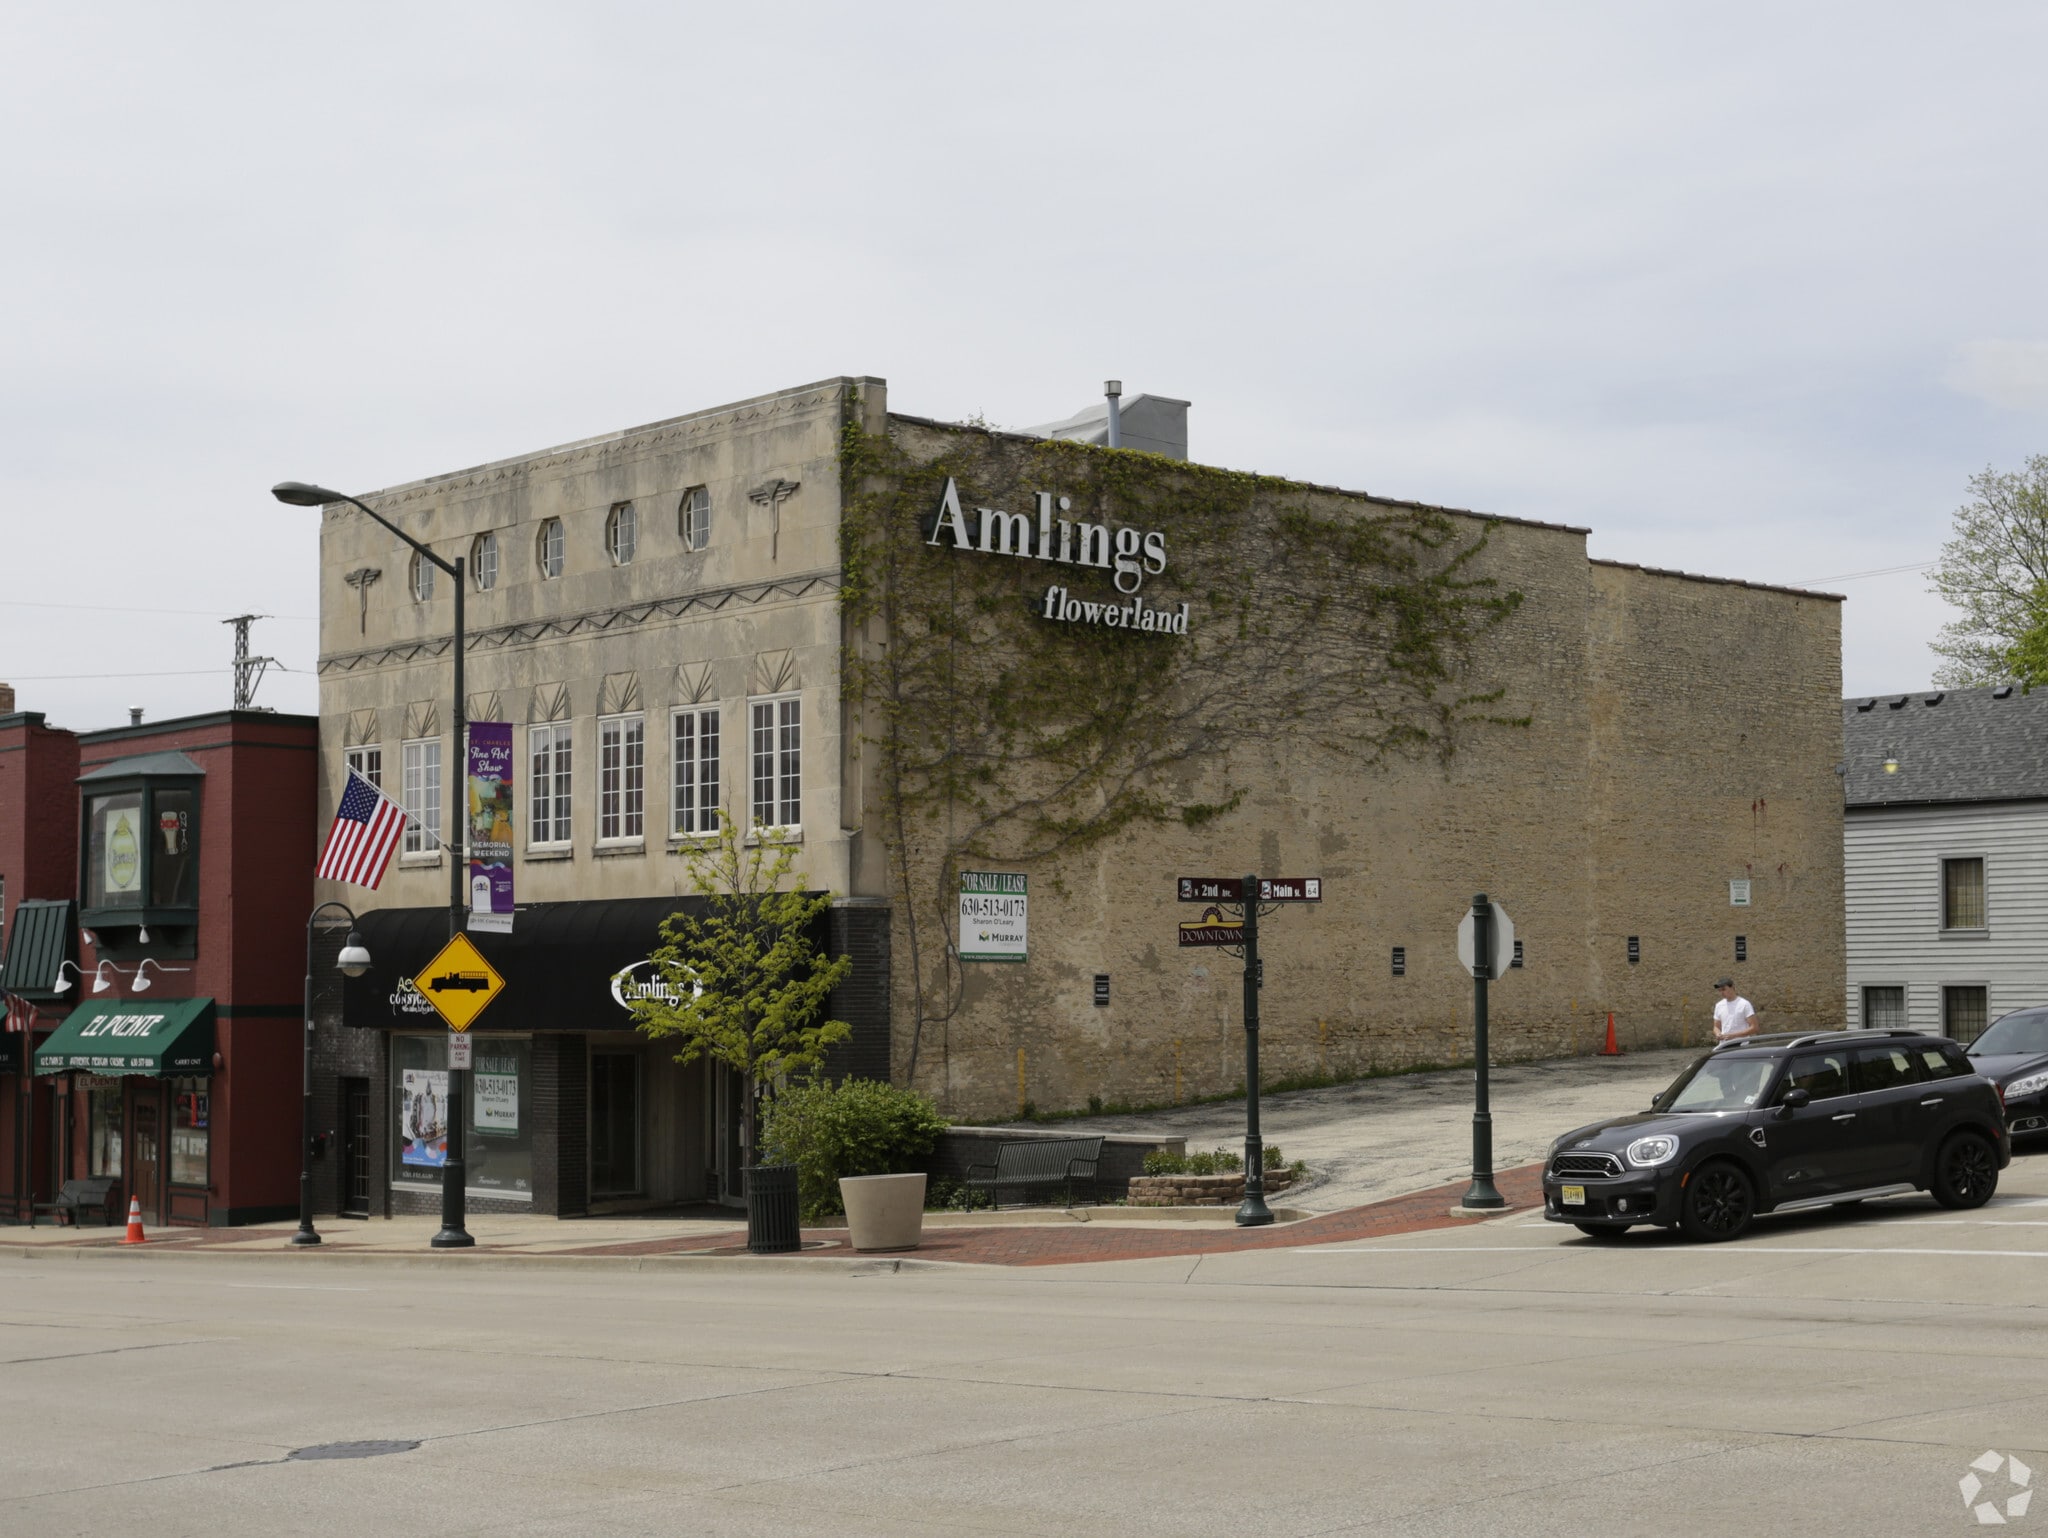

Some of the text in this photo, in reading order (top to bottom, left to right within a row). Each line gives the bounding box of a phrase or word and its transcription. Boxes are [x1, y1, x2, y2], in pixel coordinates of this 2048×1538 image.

[926, 477, 1167, 594] Amlings
[1043, 585, 1190, 635] flowerland
[470, 746, 510, 760] Fine Art
[477, 760, 503, 772] Show
[471, 841, 510, 849] MEMORIAL
[962, 873, 978, 891] FOR
[979, 873, 998, 892] SALE
[1002, 875, 1025, 892] LEASE
[1202, 884, 1218, 897] 2nd
[1273, 884, 1293, 897] Main
[1307, 888, 1317, 896] 64
[962, 898, 1025, 917] 630-513-0173
[1181, 930, 1243, 942] DOWNTOWN
[80, 1015, 165, 1036] EL PUENTE
[174, 1058, 190, 1066] CARRY
[80, 1077, 119, 1087] EL PUENTE
